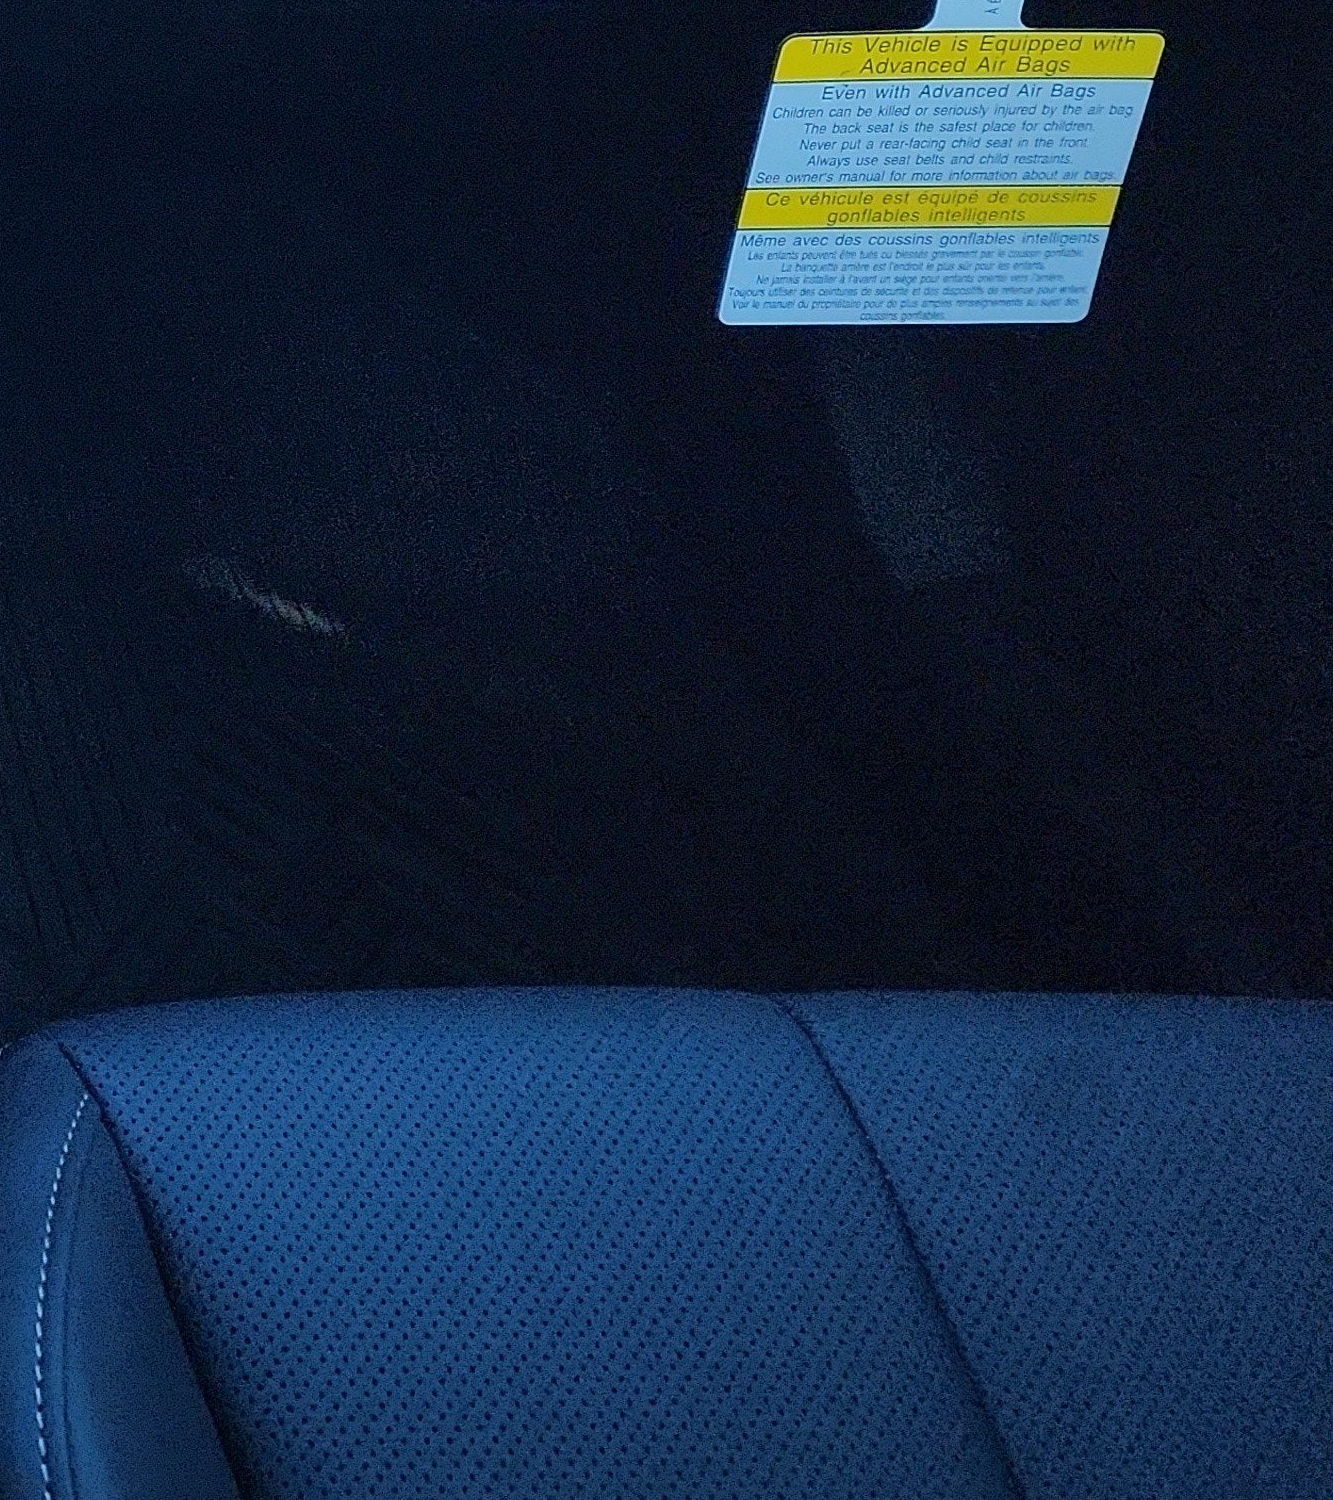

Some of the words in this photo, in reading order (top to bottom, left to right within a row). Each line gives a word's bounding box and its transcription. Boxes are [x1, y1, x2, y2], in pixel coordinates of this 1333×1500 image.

[811, 38, 852, 55] This
[865, 36, 942, 53] Vehicle
[951, 36, 968, 52] is
[979, 35, 1083, 56] Equipped
[1094, 35, 1136, 51] with
[859, 57, 967, 74] Advanced
[976, 56, 1006, 73] Air
[1017, 56, 1071, 76] Bags
[822, 86, 866, 100] Even
[876, 85, 910, 99] with
[918, 84, 1009, 99] Advanced
[1017, 84, 1043, 98] Air
[1051, 83, 1097, 100] Bags
[773, 107, 824, 119] Children
[829, 108, 851, 118] can
[857, 107, 872, 117] be
[878, 106, 909, 117] killed
[915, 107, 929, 116] or
[934, 105, 987, 118] seriously
[994, 105, 1036, 118] injured
[1042, 105, 1057, 118] by
[1063, 105, 1082, 115] the
[1088, 105, 1104, 115] air
[804, 123, 827, 134] The
[832, 122, 861, 134] back
[867, 122, 894, 133] seat
[899, 122, 909, 133] is
[914, 121, 934, 132] the
[939, 121, 977, 132] safest
[982, 121, 1016, 133] place
[1022, 121, 1038, 132] for
[799, 139, 837, 151] Never
[841, 140, 861, 153] put
[866, 141, 874, 150] a
[880, 138, 946, 152] rear-facing
[951, 138, 981, 149] child
[986, 138, 1013, 148] seat
[1018, 137, 1029, 148] in
[1035, 137, 1054, 148] the
[807, 155, 850, 168] Always
[856, 156, 878, 166] use
[884, 155, 911, 165] seat
[916, 154, 945, 165] belts
[950, 154, 974, 165] and
[979, 154, 1008, 164] child
[755, 172, 780, 184] See
[785, 172, 834, 183] owner's
[839, 171, 884, 182] manual
[890, 171, 907, 182] for
[911, 172, 943, 182] more
[948, 170, 1017, 181] information
[1022, 170, 1059, 181] about
[1062, 170, 1079, 180] air
[766, 192, 790, 207] Ce
[799, 191, 874, 206] véhicule
[883, 192, 910, 205] est
[919, 190, 979, 207] équipé
[989, 190, 1009, 204] de
[1018, 190, 1097, 204] coussins
[827, 209, 920, 226] gonflables
[928, 209, 1026, 225] intelligents
[792, 236, 828, 247] avec
[835, 234, 861, 246] des
[868, 233, 933, 246] coussins
[939, 233, 1016, 248] gonflables
[1022, 232, 1100, 247] intelligents
